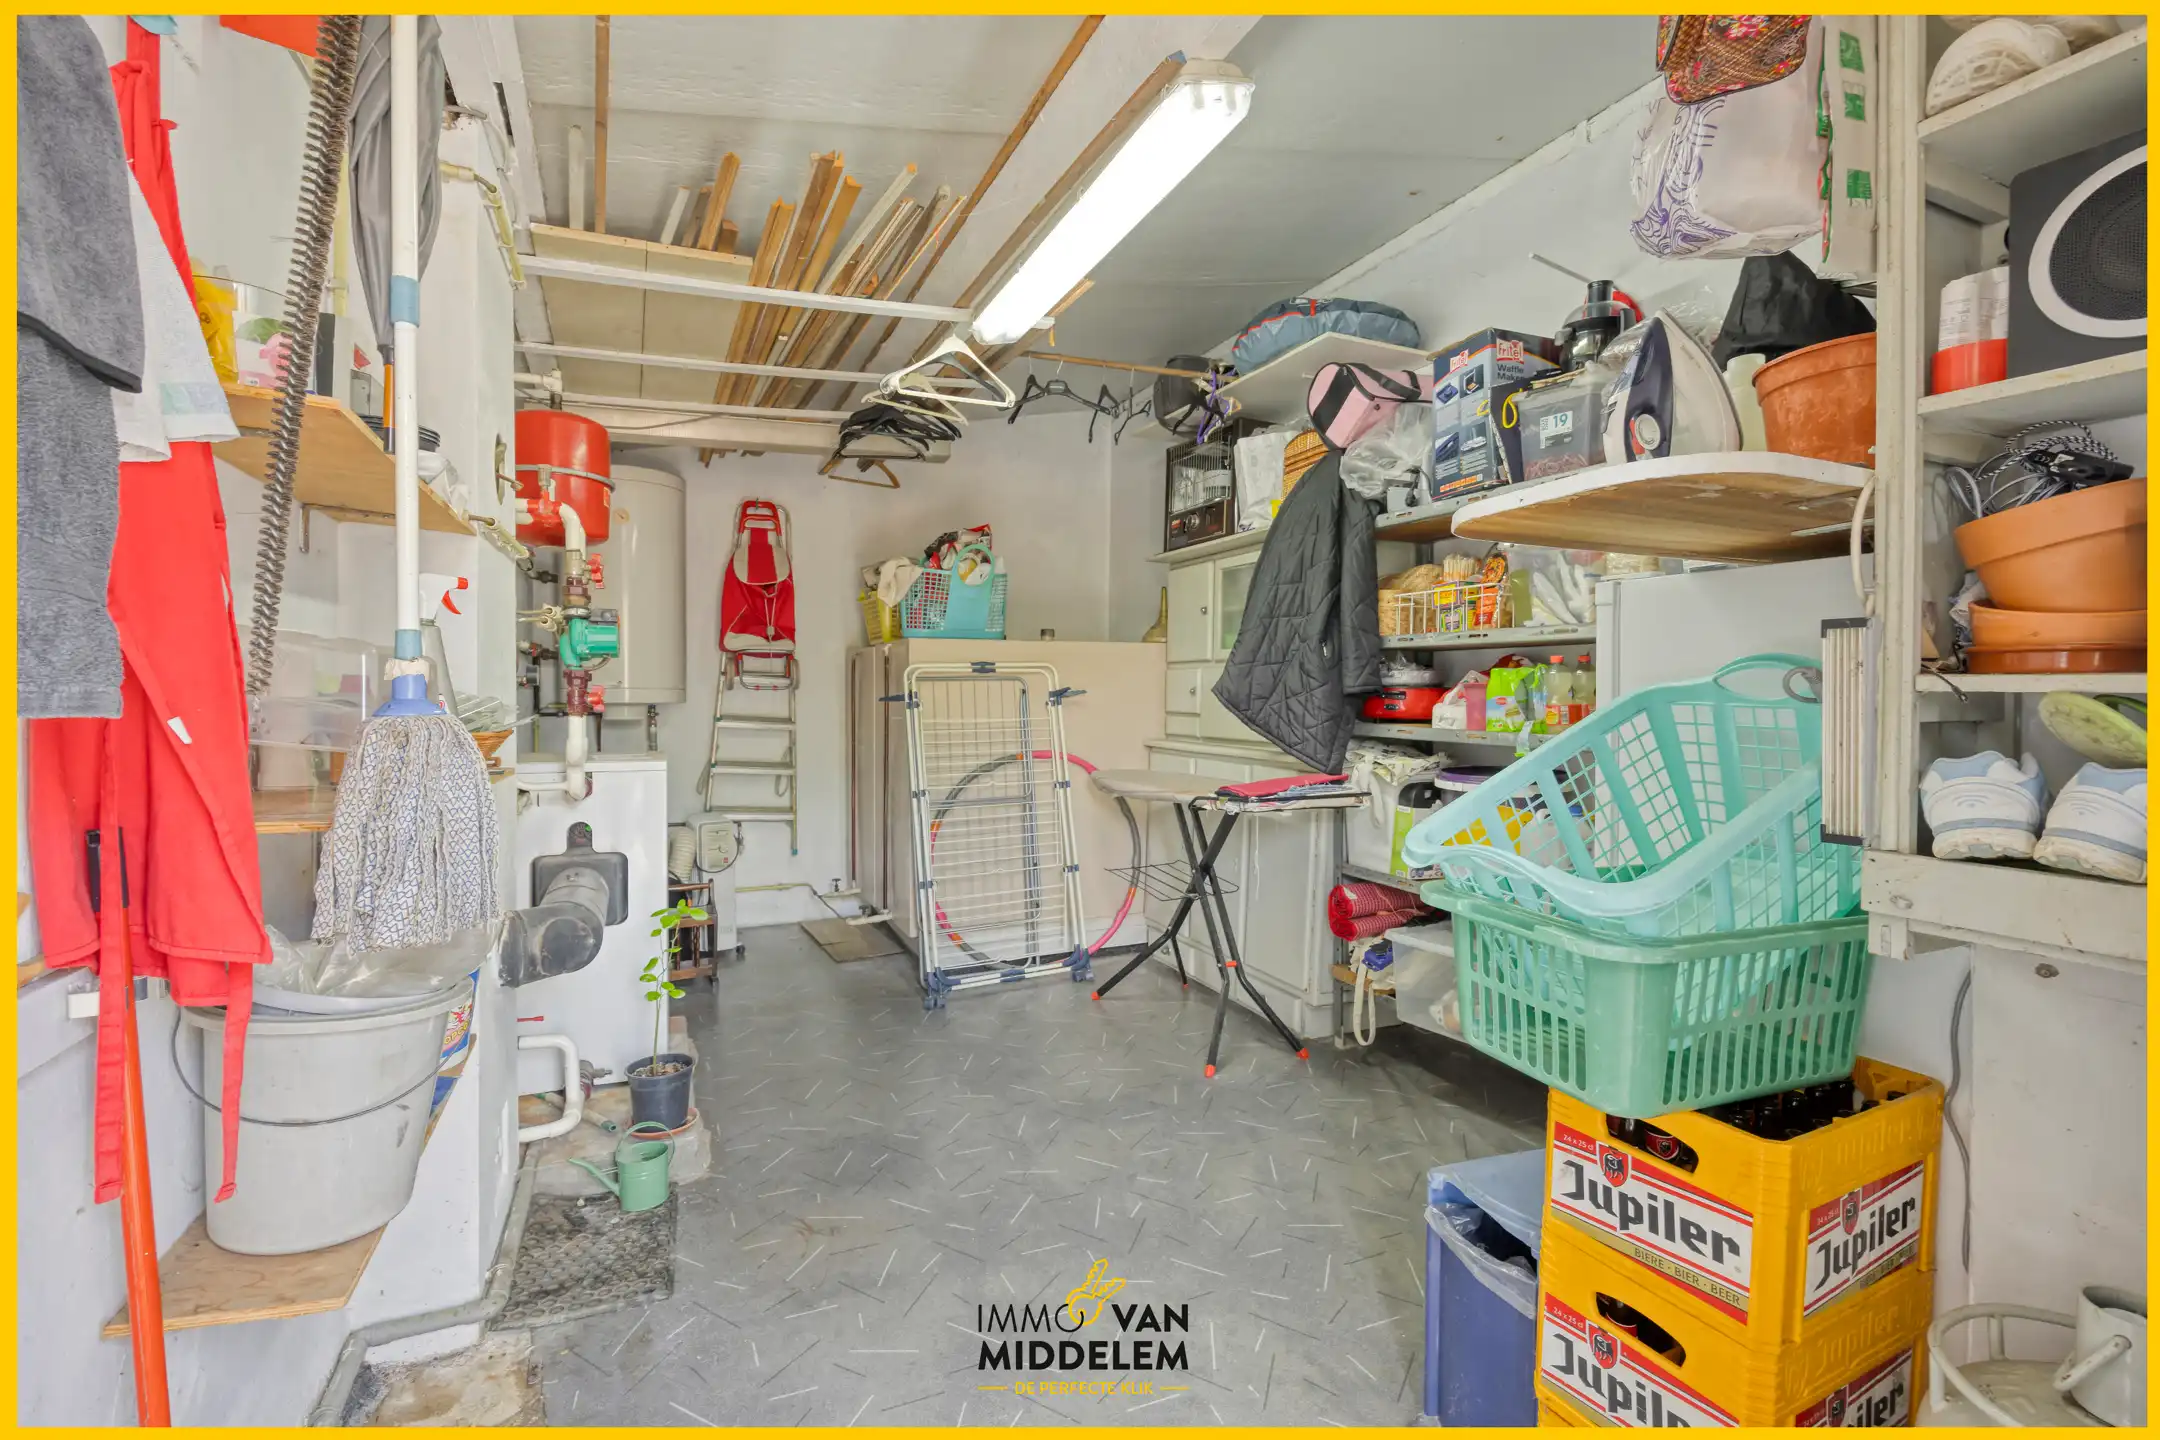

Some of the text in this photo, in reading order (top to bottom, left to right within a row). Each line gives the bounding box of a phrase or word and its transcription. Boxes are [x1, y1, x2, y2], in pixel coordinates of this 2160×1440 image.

[1497, 364, 1524, 373] Waffle
[1553, 413, 1568, 428] 19
[1563, 1134, 1572, 1143] 24
[1578, 1139, 1587, 1149] 25
[1560, 1159, 1740, 1265] Jupiler
[1814, 1197, 1916, 1292] Jupiler
[1633, 1247, 1740, 1305] BIERE BIER BEER
[1553, 1307, 1562, 1316] 24
[1568, 1316, 1577, 1324] 25
